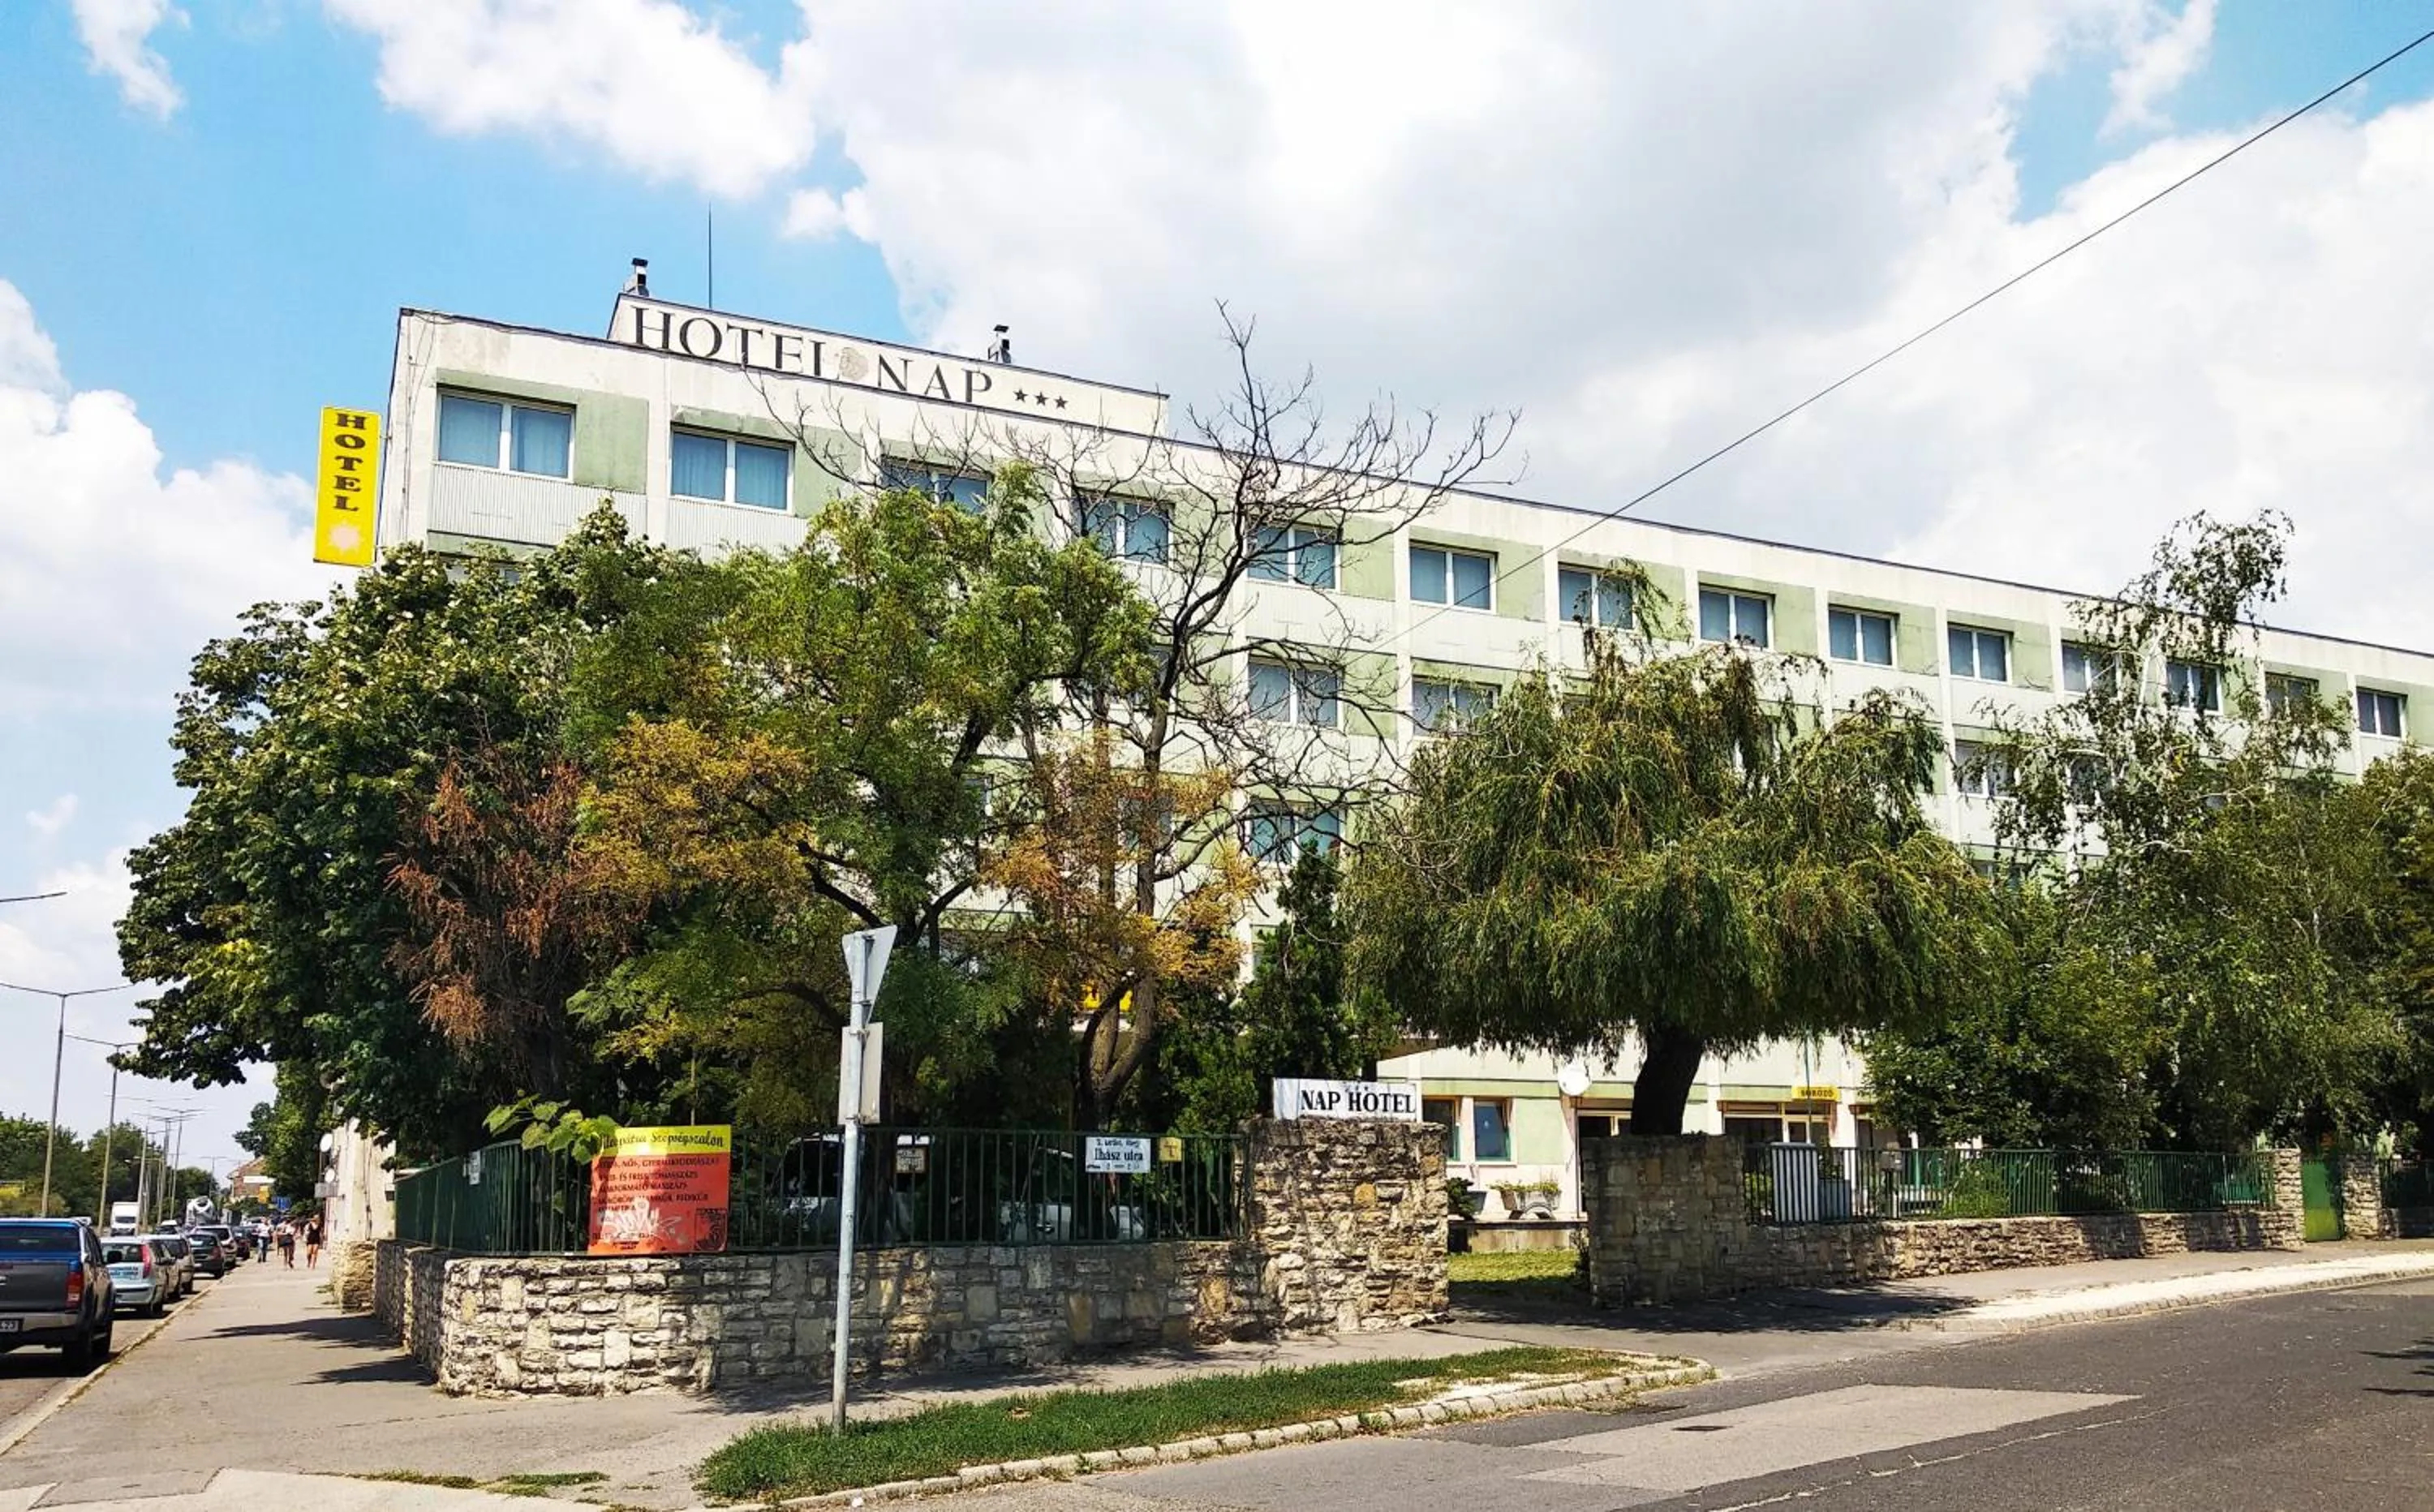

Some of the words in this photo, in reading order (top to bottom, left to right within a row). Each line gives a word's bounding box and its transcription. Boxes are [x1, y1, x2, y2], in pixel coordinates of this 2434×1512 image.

[628, 305, 841, 380] HOTEL
[877, 353, 992, 403] NAP
[333, 413, 369, 512] HOTEL
[1301, 1089, 1341, 1110] NAP
[1348, 1091, 1416, 1114] HOTEL
